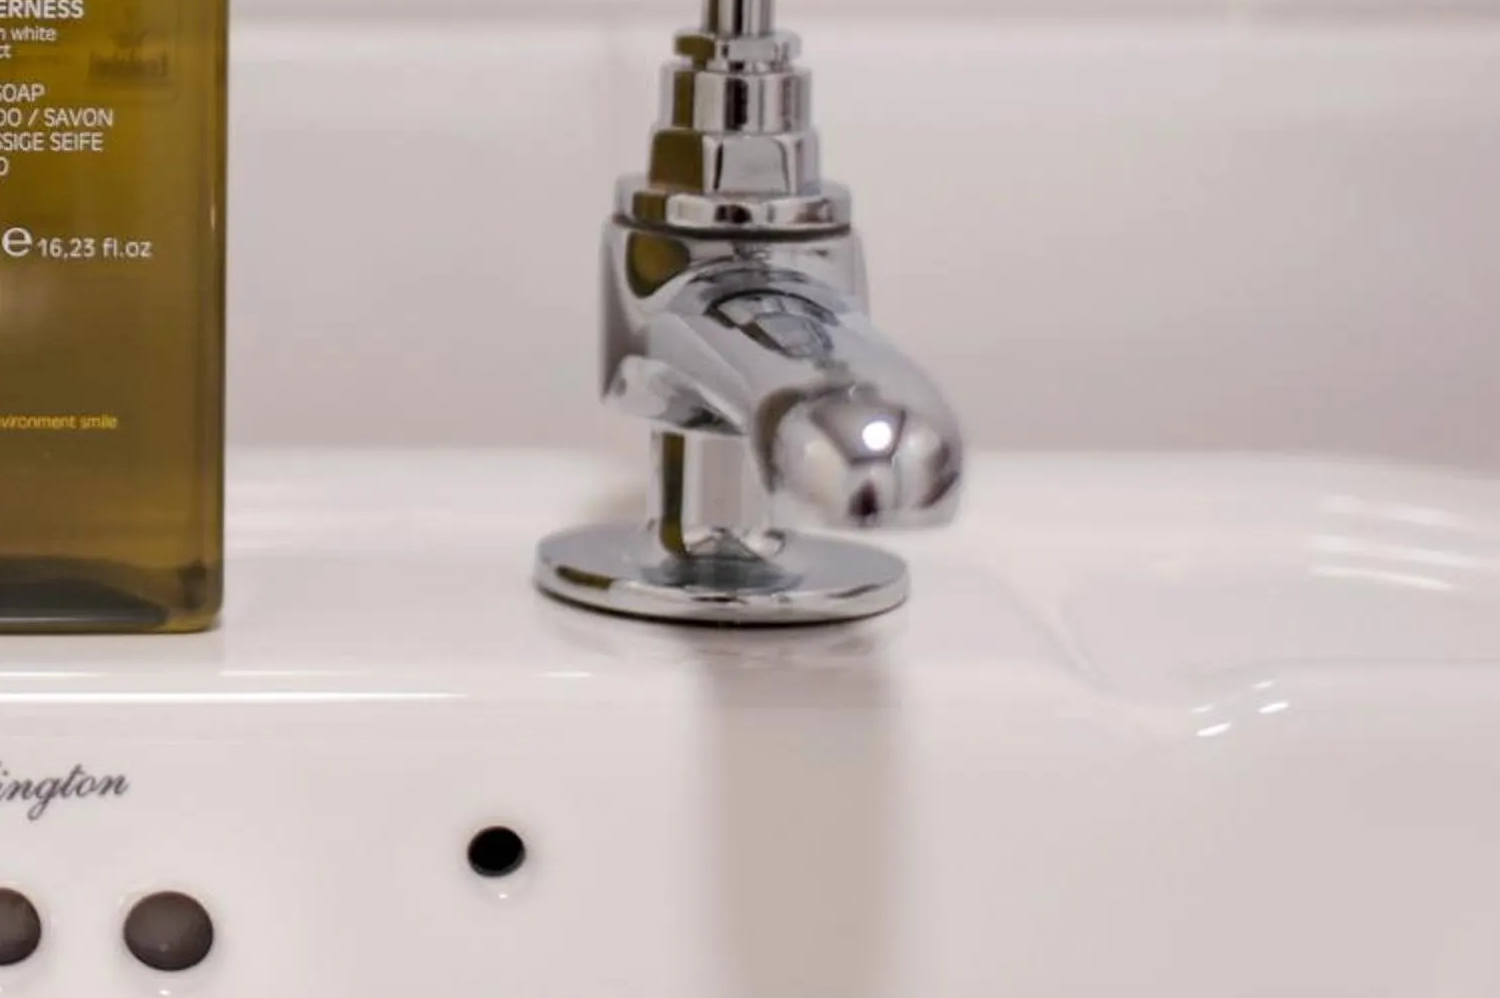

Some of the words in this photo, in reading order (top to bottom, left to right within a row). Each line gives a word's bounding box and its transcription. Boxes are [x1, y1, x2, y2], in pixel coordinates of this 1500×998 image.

[11, 26, 56, 41] white
[28, 108, 40, 128] /
[43, 108, 113, 127] SAVON
[50, 132, 104, 152] SEIFE
[102, 237, 153, 258] fl.oz
[79, 413, 118, 429] smile
